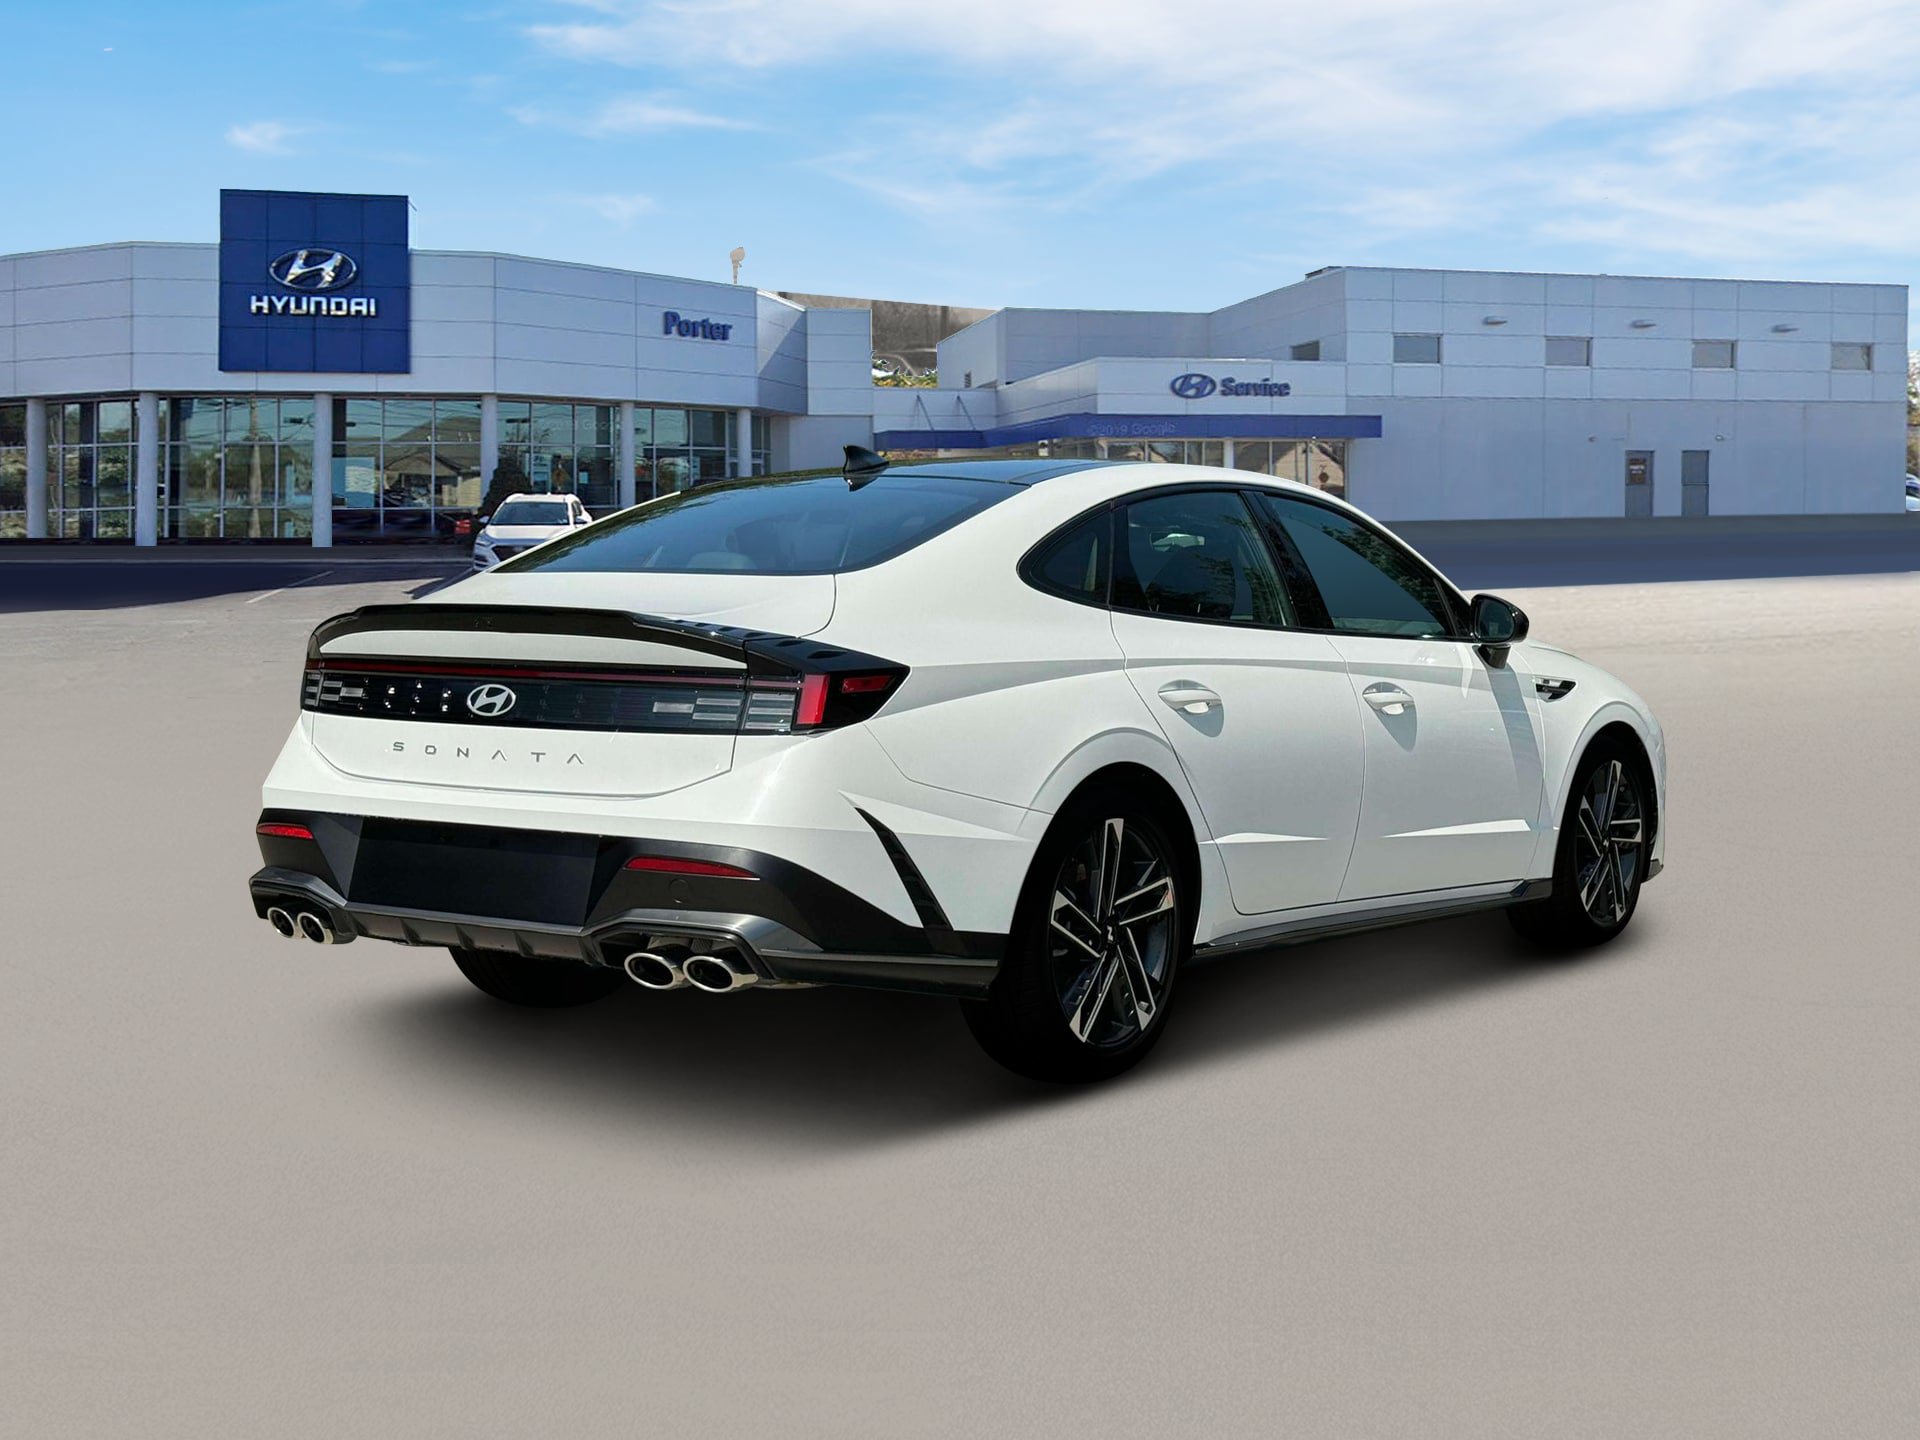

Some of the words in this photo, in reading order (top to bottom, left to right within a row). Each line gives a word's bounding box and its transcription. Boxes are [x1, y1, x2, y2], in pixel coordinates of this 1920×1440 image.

[250, 295, 377, 317] HYUNDAI
[663, 311, 733, 341] Porter
[1221, 376, 1291, 397] Service
[392, 741, 584, 765] SONATA
